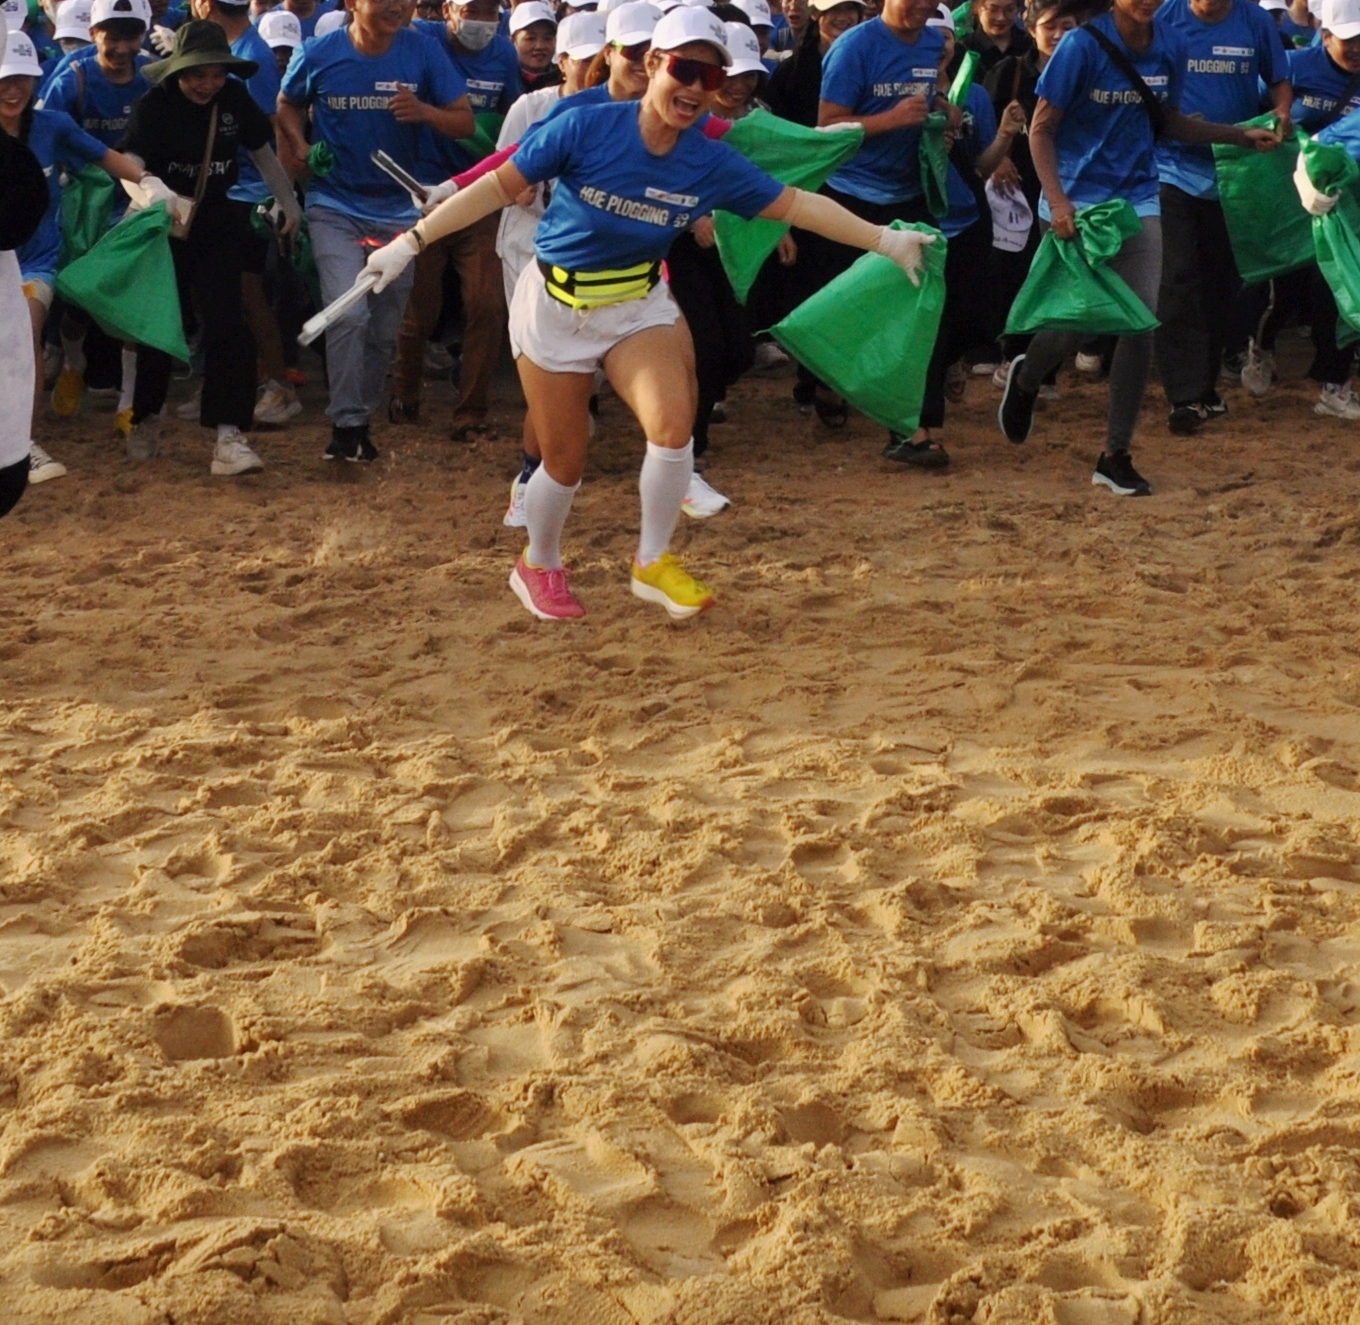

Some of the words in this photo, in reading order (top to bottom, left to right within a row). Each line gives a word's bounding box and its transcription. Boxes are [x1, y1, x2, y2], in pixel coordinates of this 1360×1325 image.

[1187, 59, 1236, 73] PLOGGING
[580, 185, 607, 208] HUE
[606, 195, 670, 226] PLOGGING
